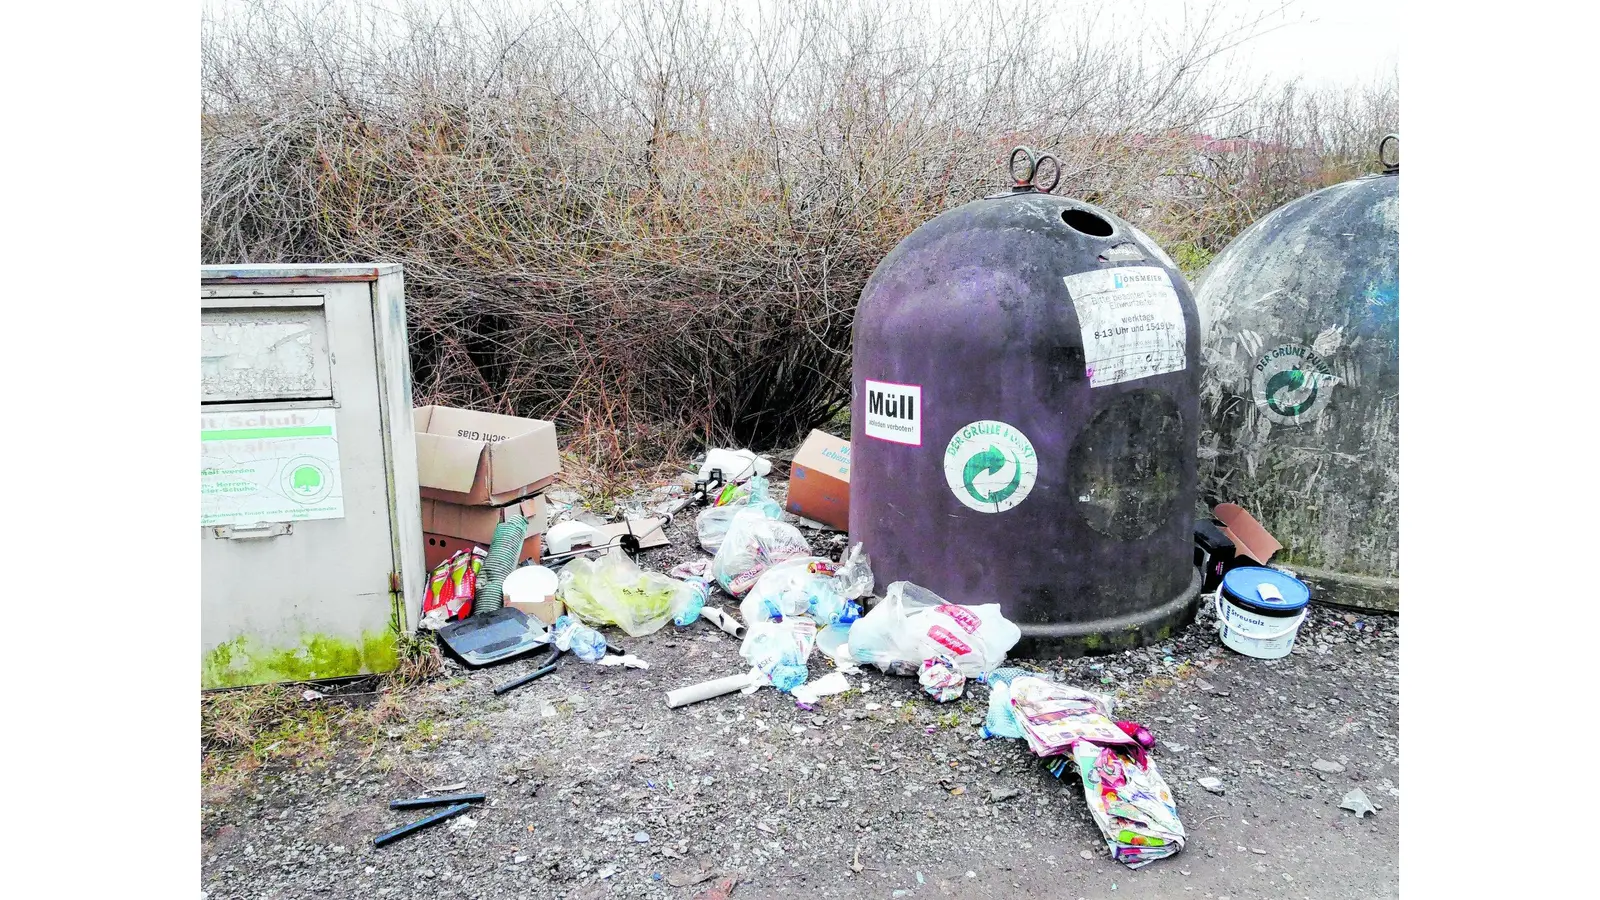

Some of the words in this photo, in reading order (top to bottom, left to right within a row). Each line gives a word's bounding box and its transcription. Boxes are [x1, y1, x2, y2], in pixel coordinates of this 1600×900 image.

[1121, 313, 1154, 325] werktags
[1094, 328, 1114, 340] 8-13
[1115, 326, 1129, 336] Uhr
[1131, 324, 1144, 334] und
[1256, 355, 1273, 372] DER
[1272, 346, 1305, 359] GRÜNE
[869, 390, 914, 420] Müll
[227, 413, 304, 428] Schuh
[886, 422, 914, 434] verboten!
[457, 429, 480, 441] Glas
[947, 436, 965, 457] DER
[1231, 609, 1265, 627] Streusalz
